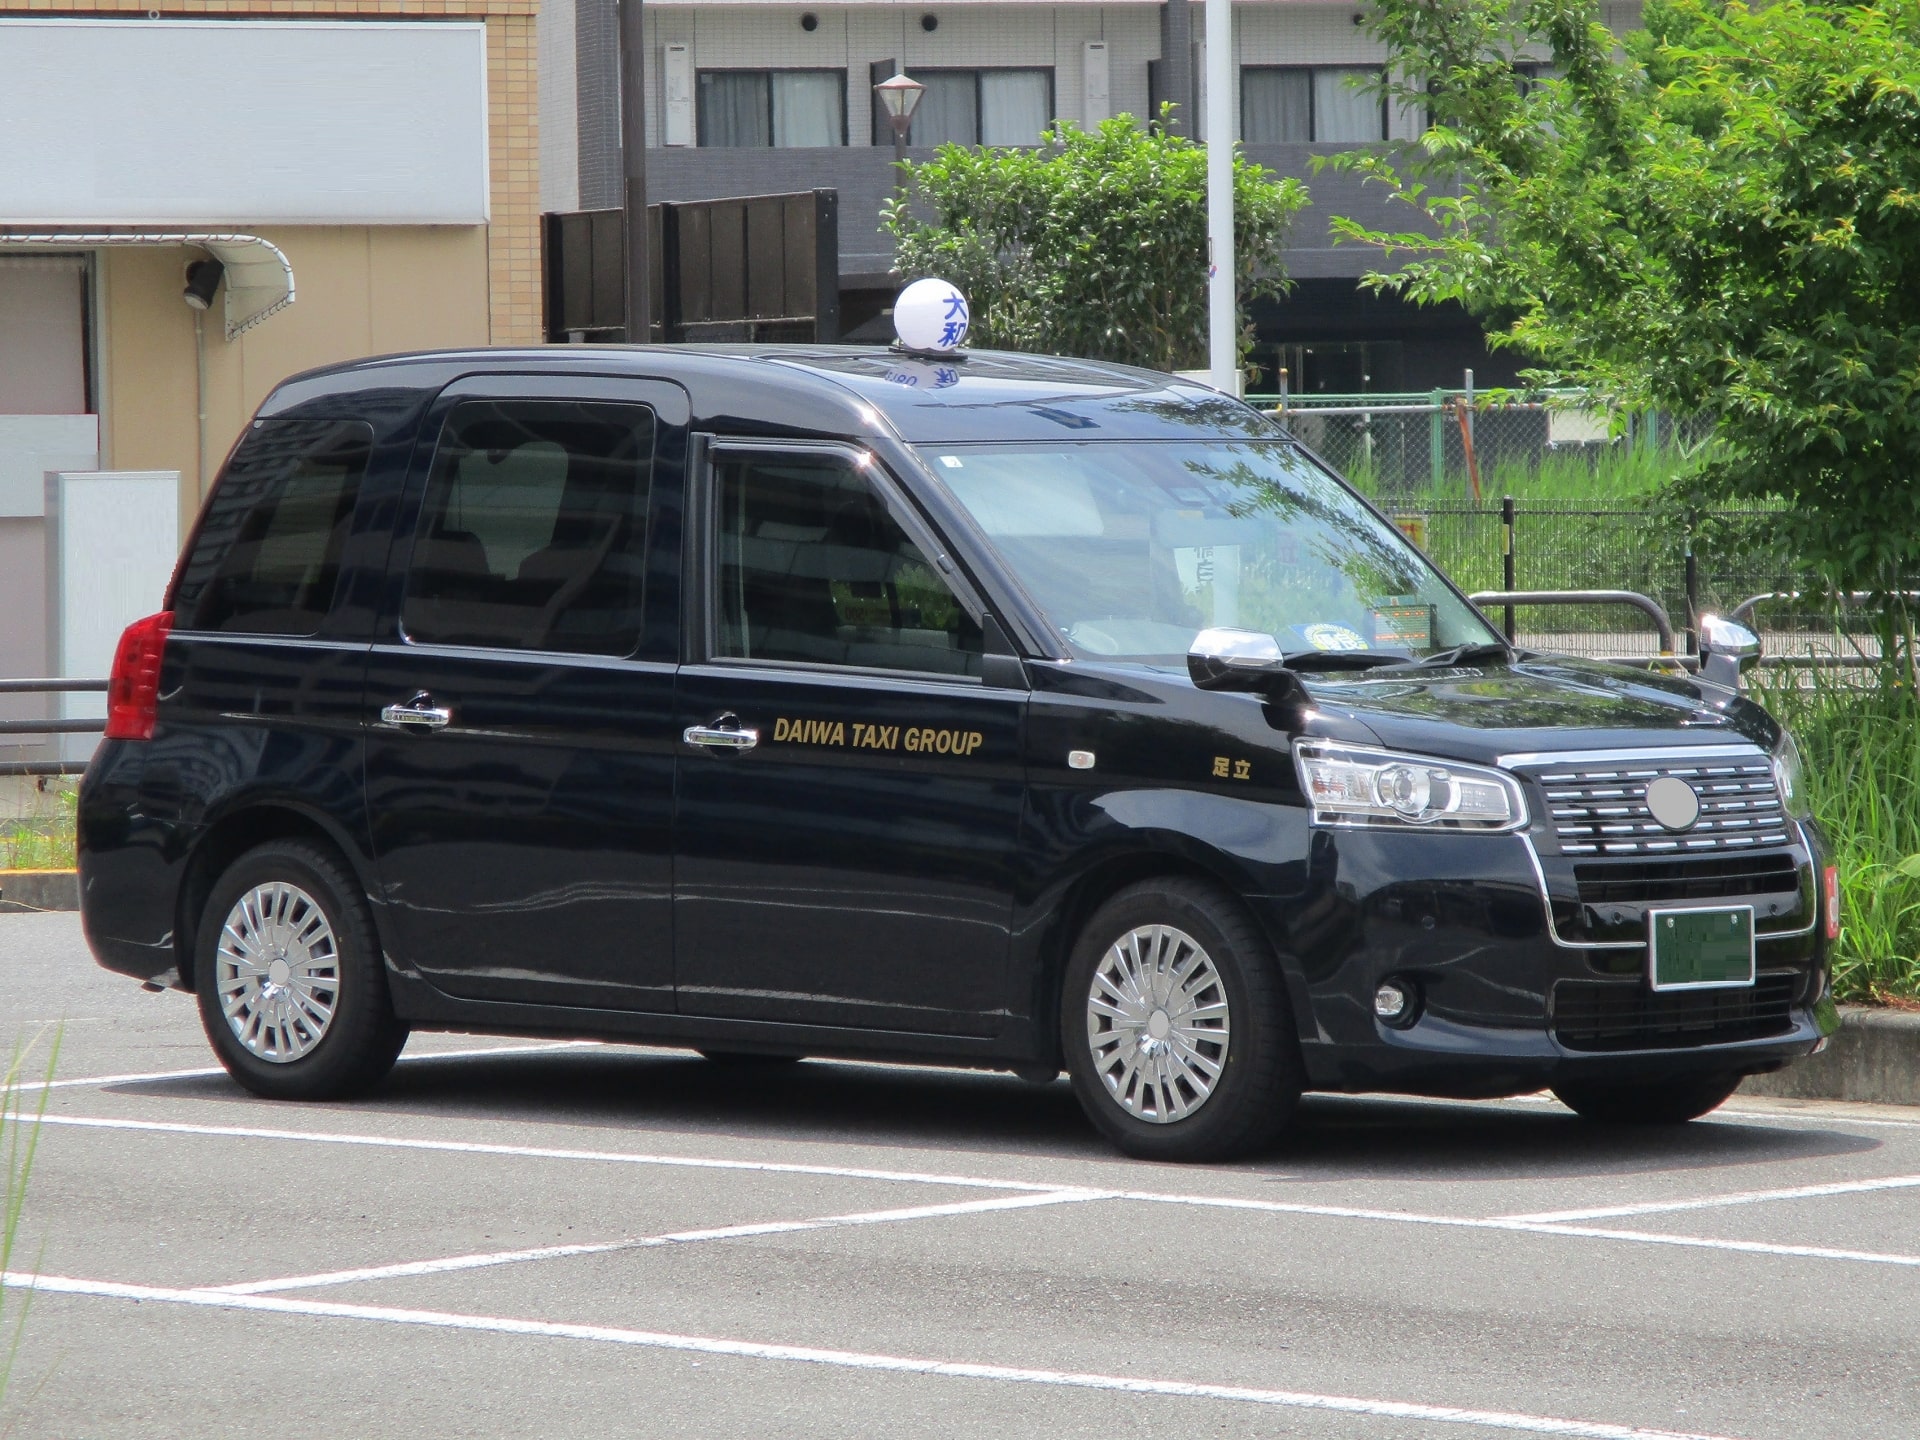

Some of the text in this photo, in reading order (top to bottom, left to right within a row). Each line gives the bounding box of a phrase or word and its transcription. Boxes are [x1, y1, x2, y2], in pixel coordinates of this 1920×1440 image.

[937, 291, 967, 347] 大和
[773, 718, 983, 756] DAIWA TAXI GROUP
[1212, 756, 1251, 780] 足立
